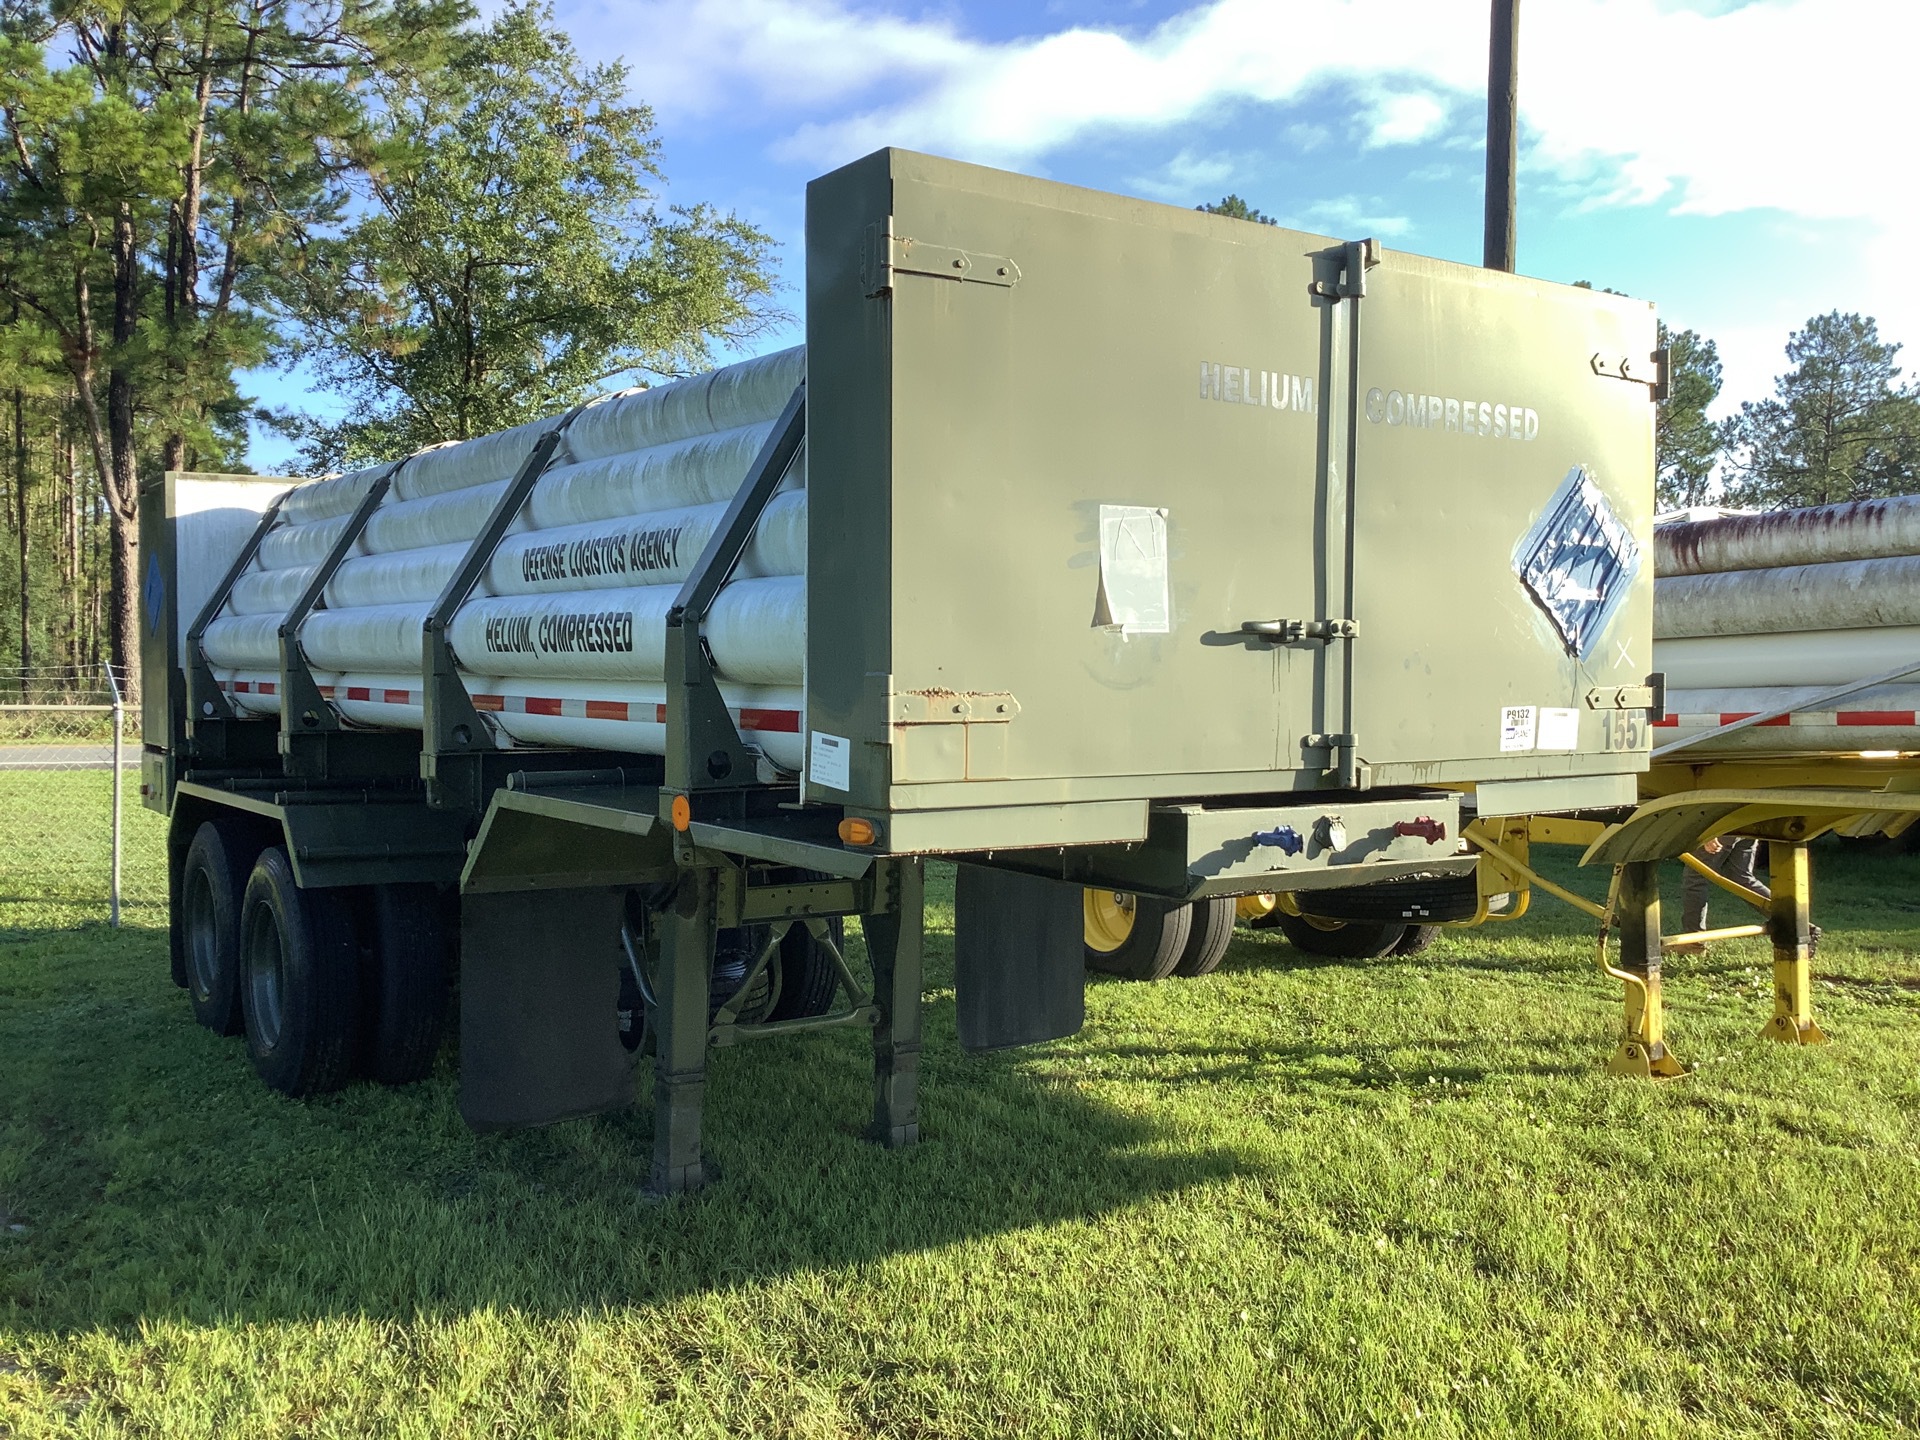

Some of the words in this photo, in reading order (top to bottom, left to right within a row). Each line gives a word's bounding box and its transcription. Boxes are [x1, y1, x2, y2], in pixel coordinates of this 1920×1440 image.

[1365, 386, 1540, 441] COMPRESSED
[522, 543, 567, 582] DEFENSE
[569, 534, 626, 578] LOGISTICS
[630, 527, 682, 572] AGENCY
[485, 616, 538, 660] HELIUM,
[538, 611, 633, 653] COMPRESSED
[1506, 709, 1530, 720] P9132
[1602, 710, 1647, 750] 1557
